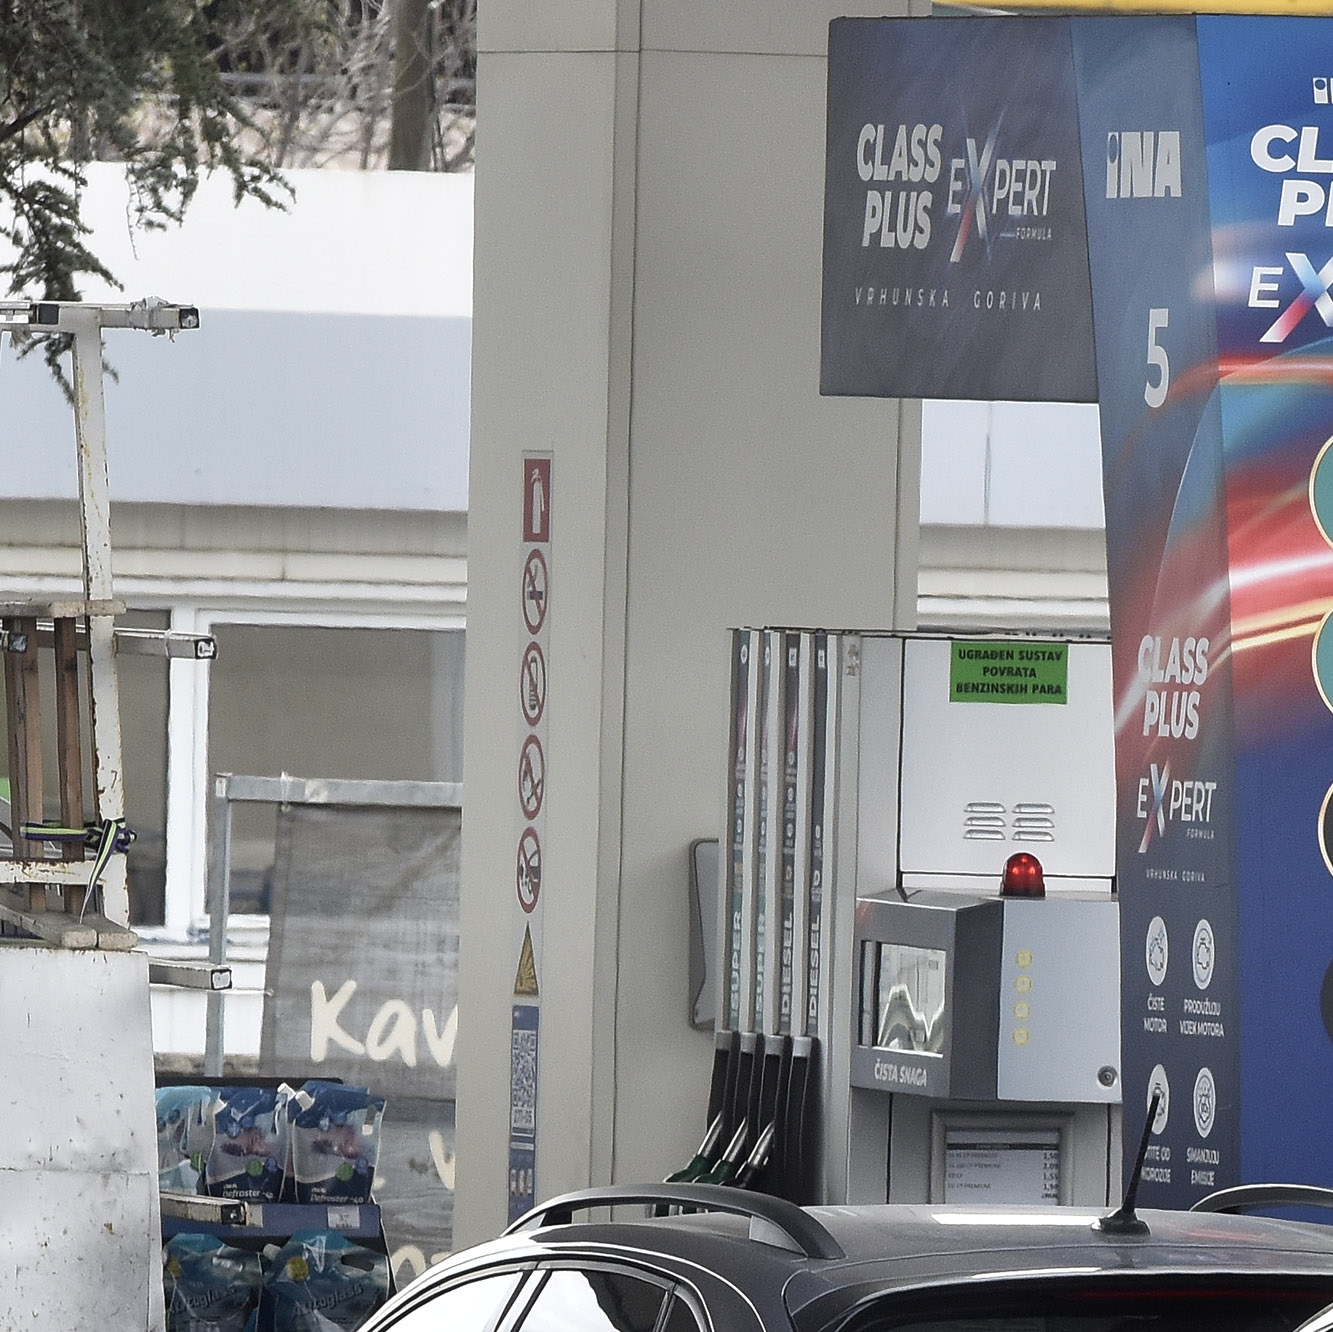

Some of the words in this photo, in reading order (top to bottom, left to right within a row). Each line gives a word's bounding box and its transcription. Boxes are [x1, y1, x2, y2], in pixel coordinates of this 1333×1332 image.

[857, 123, 943, 183] CLASS
[862, 190, 933, 249] PLUS
[947, 138, 1057, 262] EXPERT
[1016, 227, 1052, 240] FORMULA
[855, 287, 949, 308] VRHUNSKA
[973, 290, 1042, 310] GORIVA
[1144, 308, 1170, 408] 5
[983, 666, 1037, 678] POVRATA
[1018, 650, 1063, 661] SUSTAV
[1138, 634, 1210, 686] CLASS
[956, 682, 1028, 694] BENZINSKIH
[1032, 683, 1062, 694] PARA
[1143, 690, 1201, 740] PLUS
[1137, 760, 1217, 853] EXPERT
[781, 912, 793, 1015] DIESEL
[808, 914, 821, 1017] DIESEL
